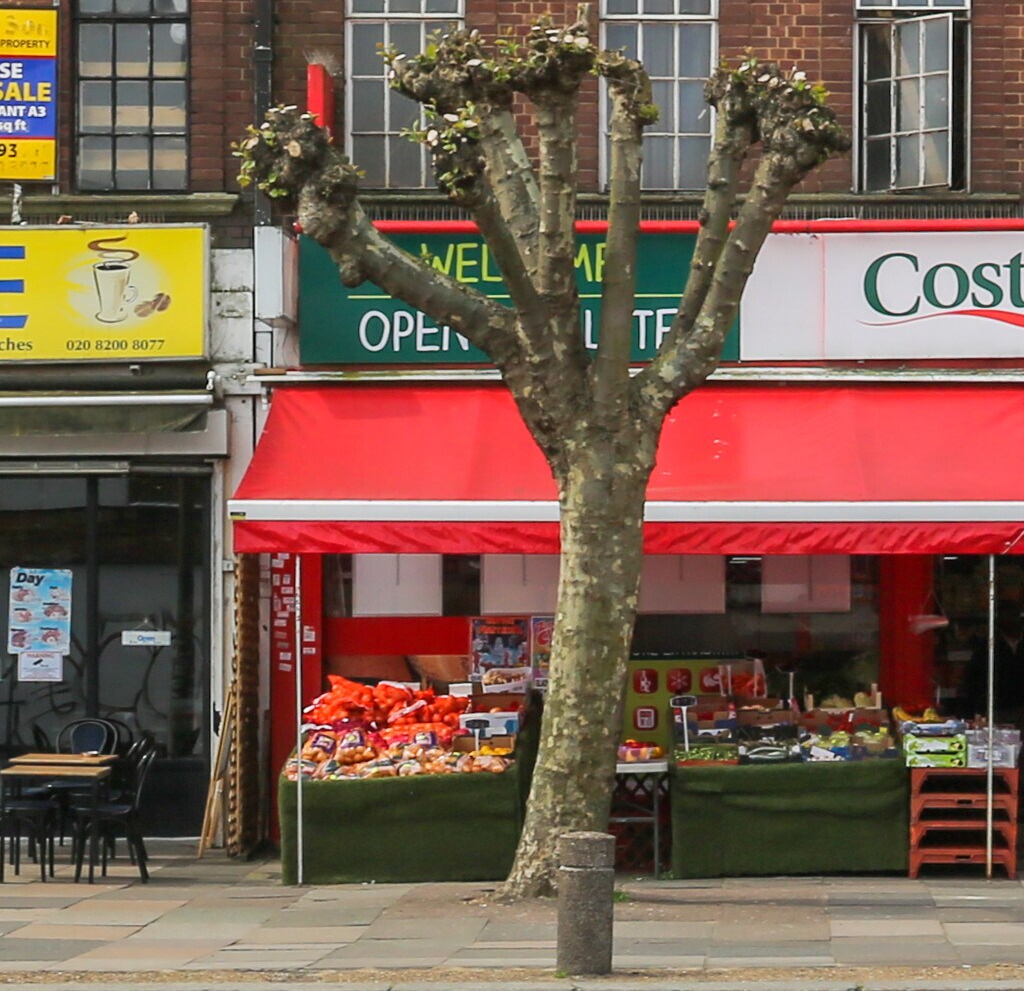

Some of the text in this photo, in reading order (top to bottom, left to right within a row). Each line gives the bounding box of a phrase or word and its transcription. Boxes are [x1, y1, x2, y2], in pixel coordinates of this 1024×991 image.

[0, 38, 50, 48] PROPERTY
[27, 105, 47, 118] A3
[66, 340, 91, 351] 020
[95, 340, 128, 351] 8200
[132, 339, 165, 351] 8077
[16, 572, 45, 586] Day
